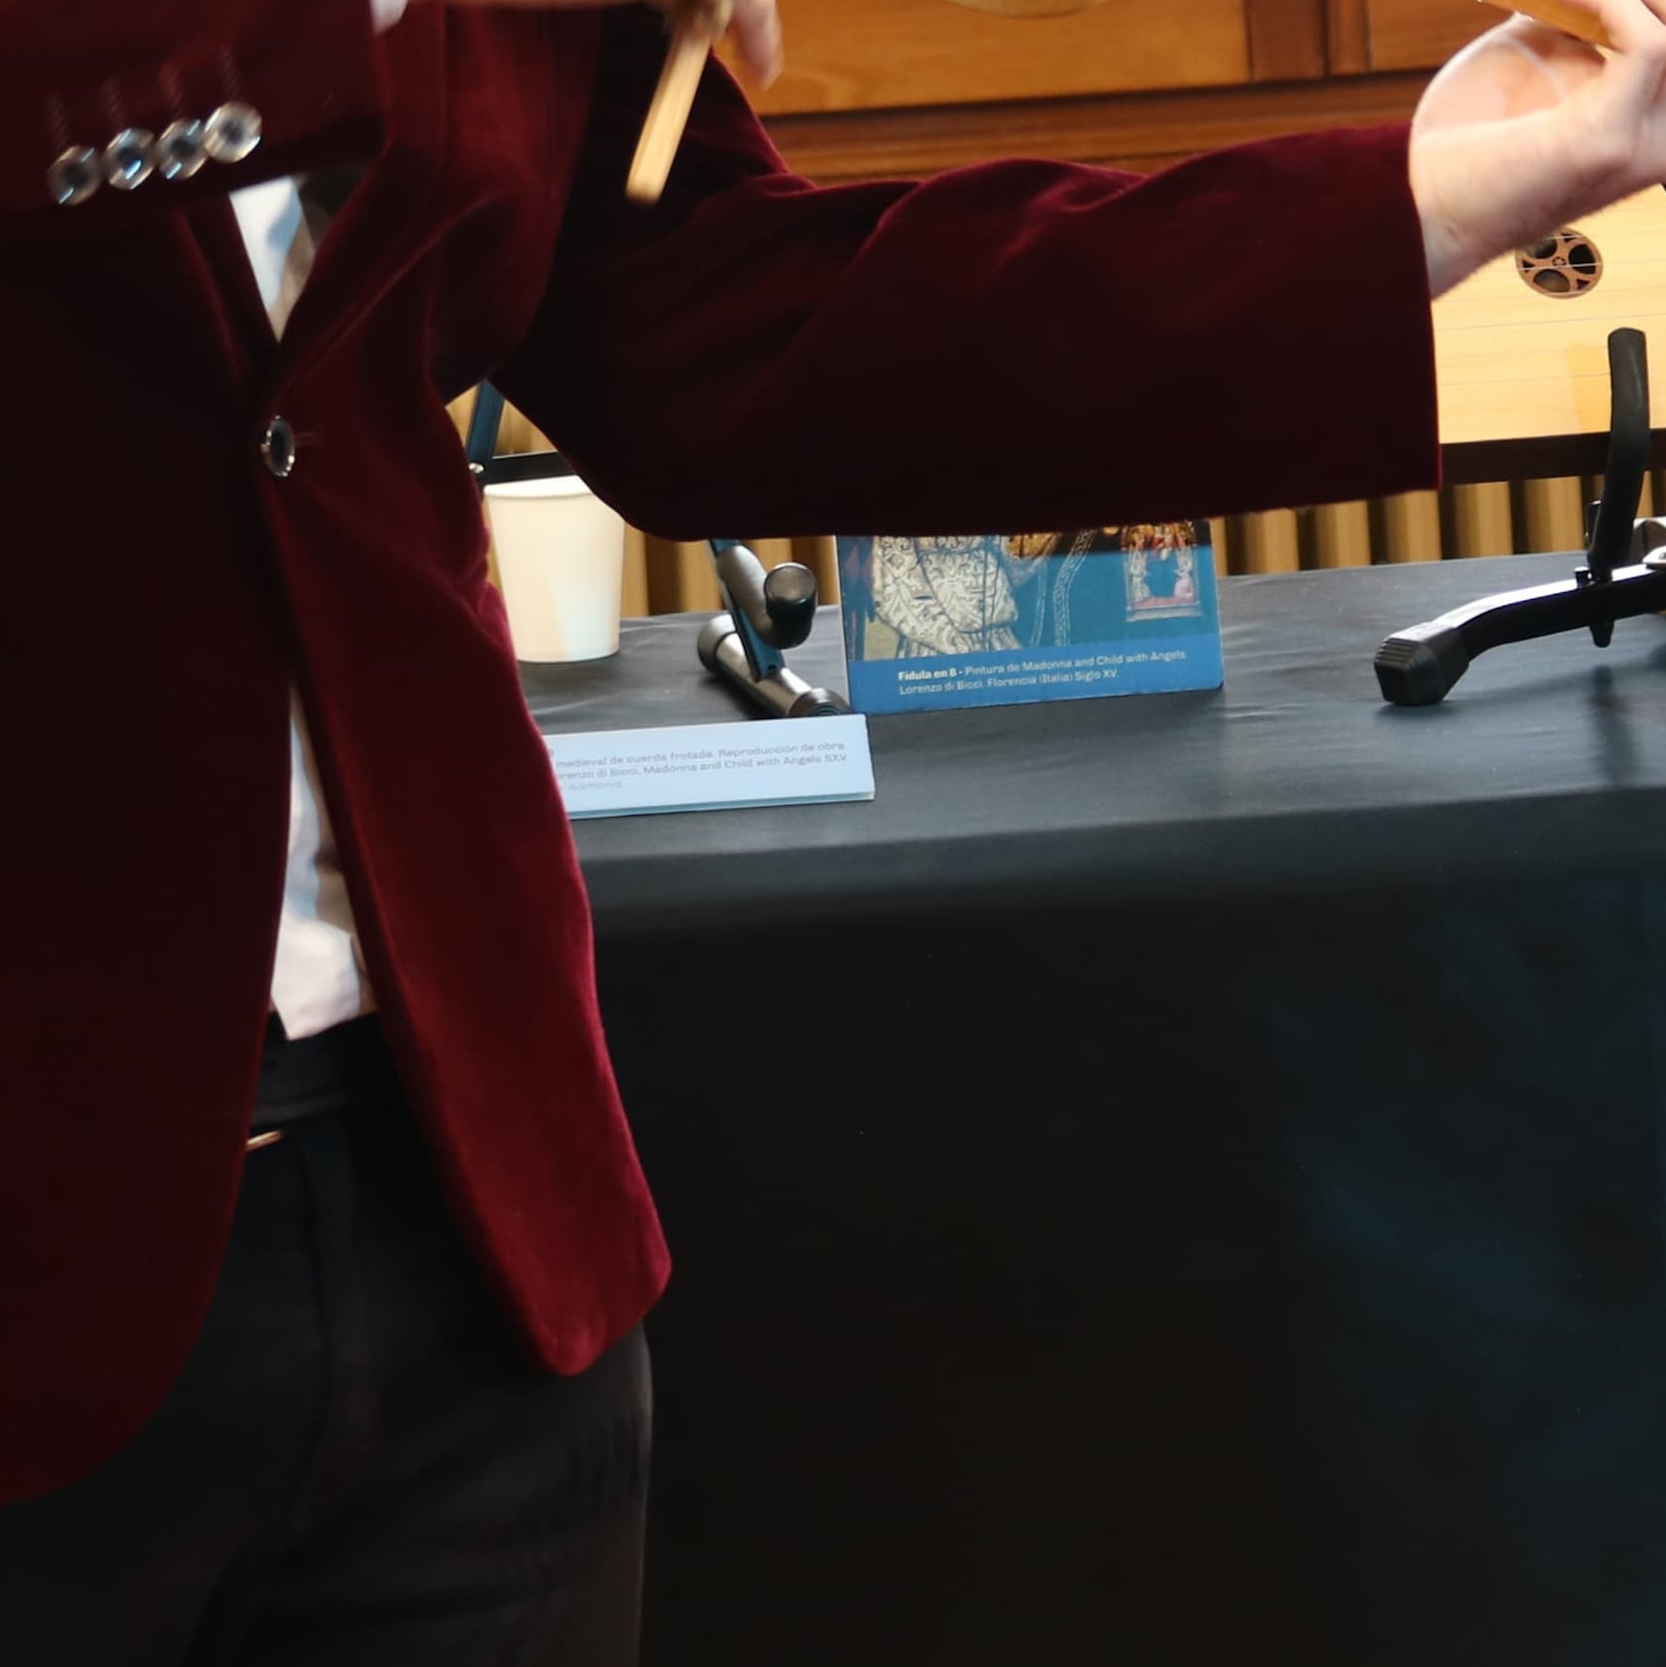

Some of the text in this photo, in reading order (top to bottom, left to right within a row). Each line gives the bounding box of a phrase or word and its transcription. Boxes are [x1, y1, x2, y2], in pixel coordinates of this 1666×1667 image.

[933, 669, 947, 678] en
[964, 662, 1004, 675] Pintura
[1007, 661, 1019, 672] de
[1022, 657, 1071, 671] Madonna
[1074, 655, 1094, 666] and
[1096, 653, 1123, 665] Child
[1125, 651, 1148, 662] with
[899, 681, 942, 694] Lorenzo
[944, 680, 954, 691] di
[987, 674, 1036, 687] Florencia
[1074, 669, 1101, 683] Siglo
